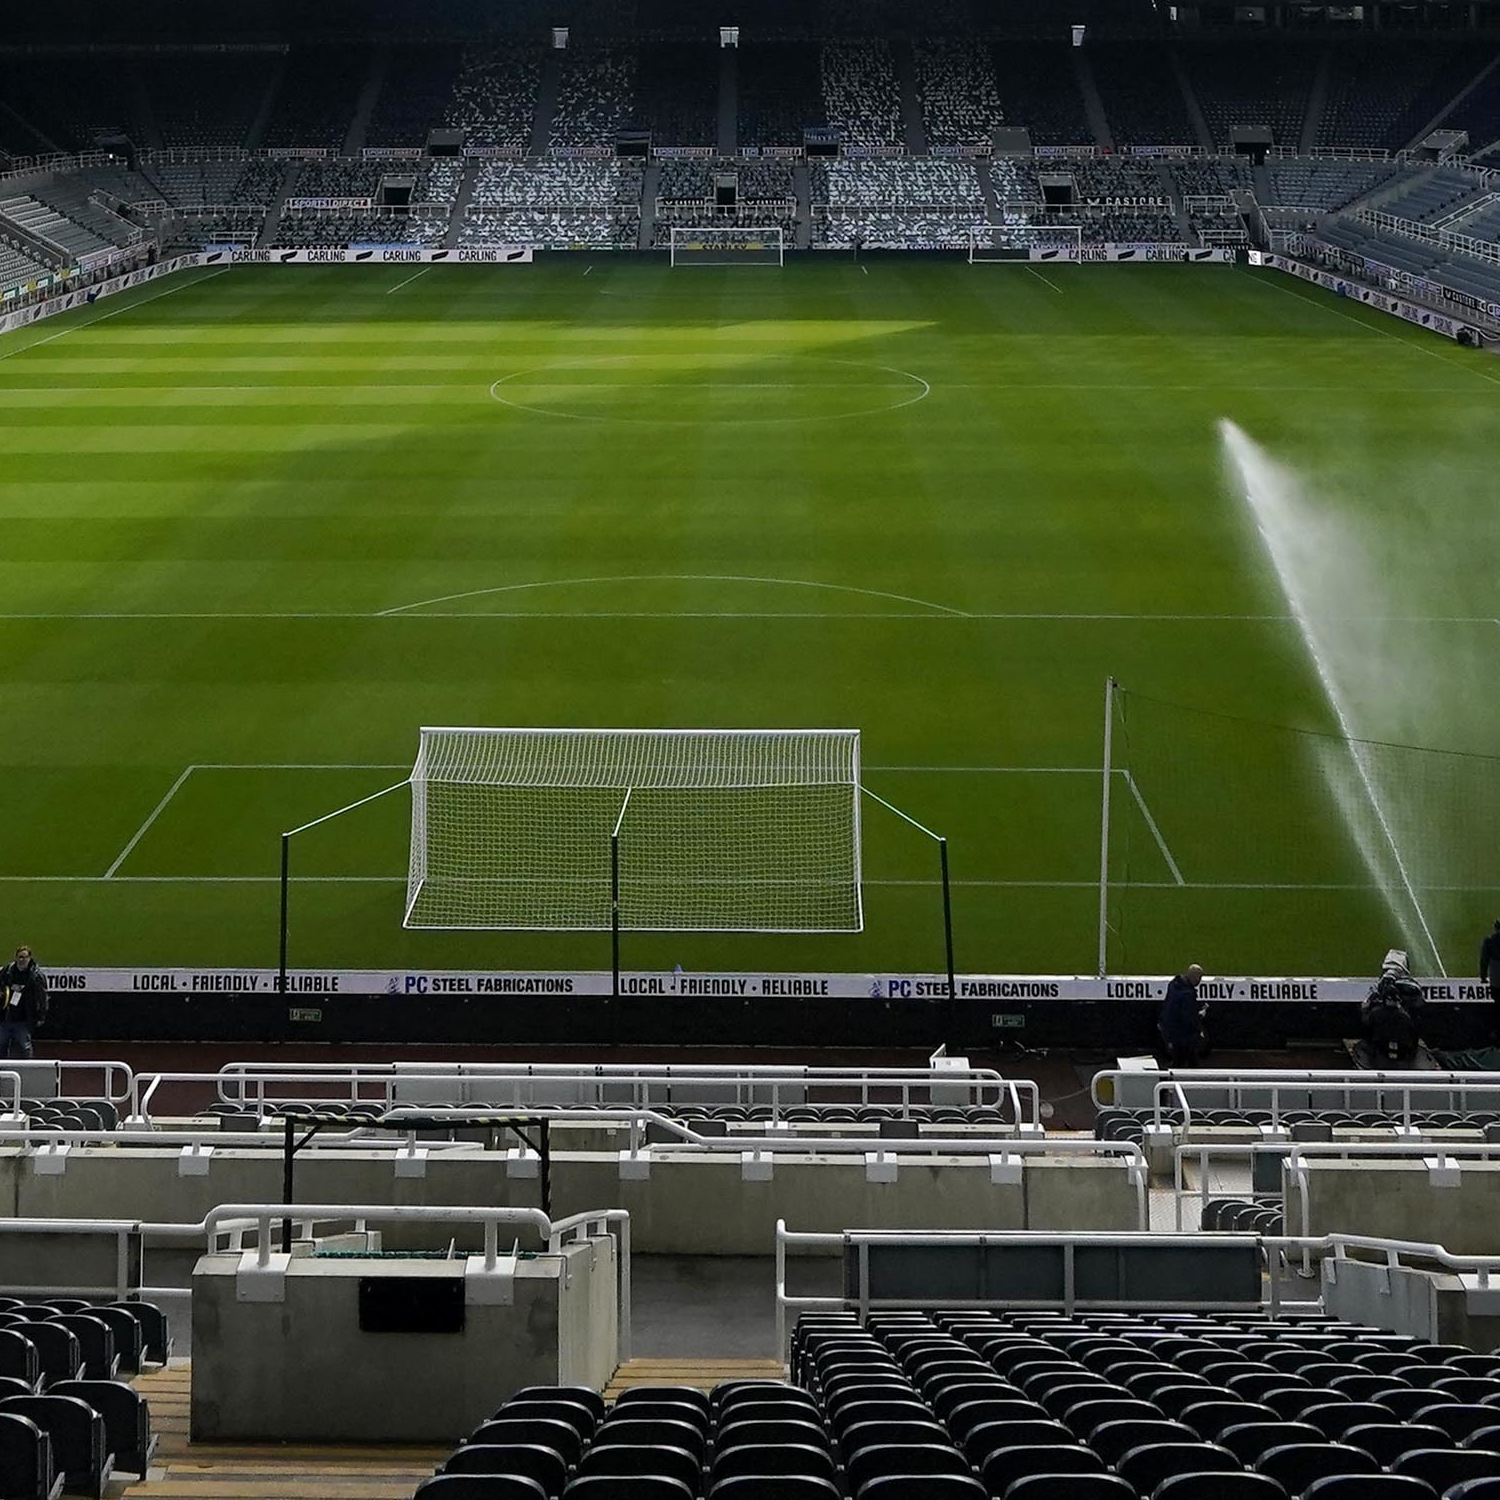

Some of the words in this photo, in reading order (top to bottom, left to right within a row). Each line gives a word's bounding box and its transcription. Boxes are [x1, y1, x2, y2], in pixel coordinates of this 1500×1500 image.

[232, 251, 270, 261] CARLING
[308, 251, 346, 261] CARLING
[383, 251, 421, 261] CARLING
[459, 251, 497, 261] CARLING
[1146, 250, 1185, 261] CARLING
[133, 975, 176, 990] LOCAL
[192, 975, 257, 990] FRIENDLY
[273, 976, 338, 991] RELIABLE
[405, 976, 427, 993] PC
[432, 978, 472, 992] STEEL
[477, 978, 573, 993] FABRICATIONS
[620, 978, 665, 994] LOCAL
[681, 979, 746, 995] FRIENDLY
[762, 980, 827, 996] RELIABLE
[889, 980, 911, 997] PC
[961, 982, 1058, 998] FABRICATIONS
[1107, 982, 1152, 998] LOCAL
[1250, 983, 1316, 999] RELIABLE
[1421, 986, 1455, 1000] TEEL
